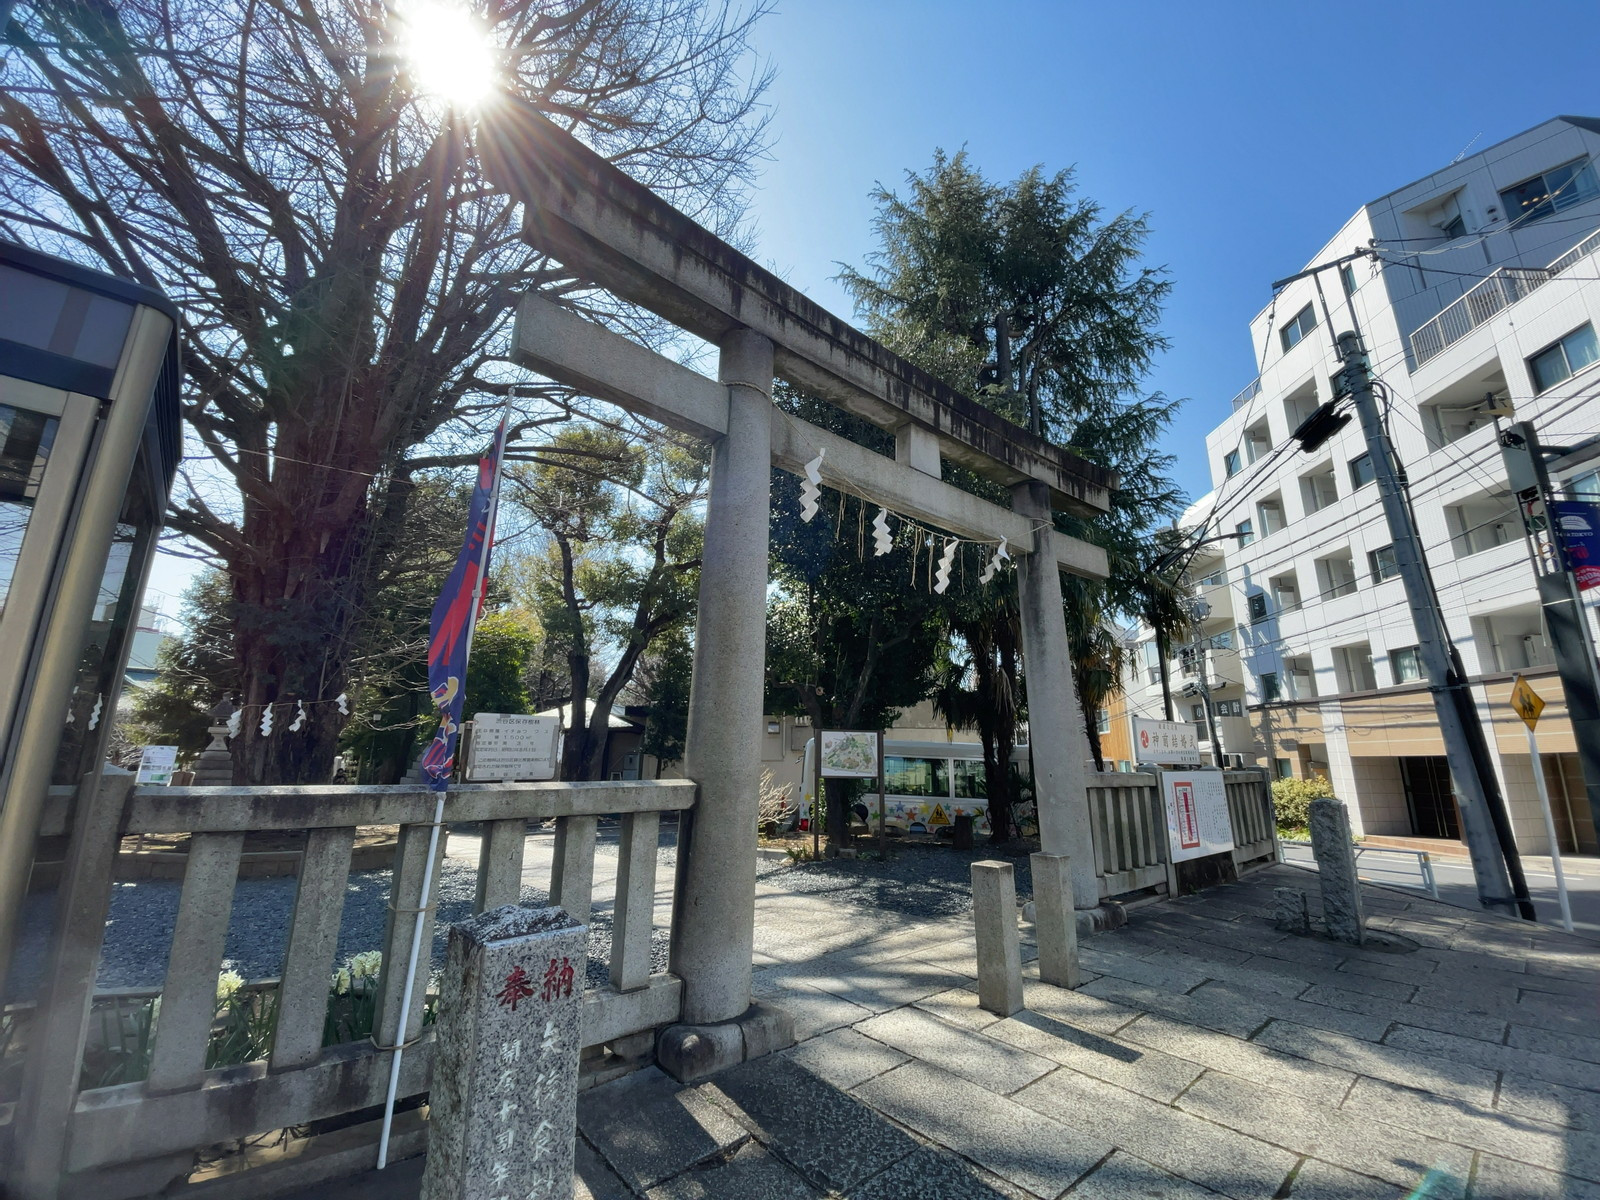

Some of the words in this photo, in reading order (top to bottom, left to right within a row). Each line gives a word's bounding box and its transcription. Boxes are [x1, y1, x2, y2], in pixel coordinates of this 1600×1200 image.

[1152, 731, 1196, 750] 神前結婚式
[496, 957, 574, 1011] 奉納
[491, 1038, 522, 1199] 開店十周年
